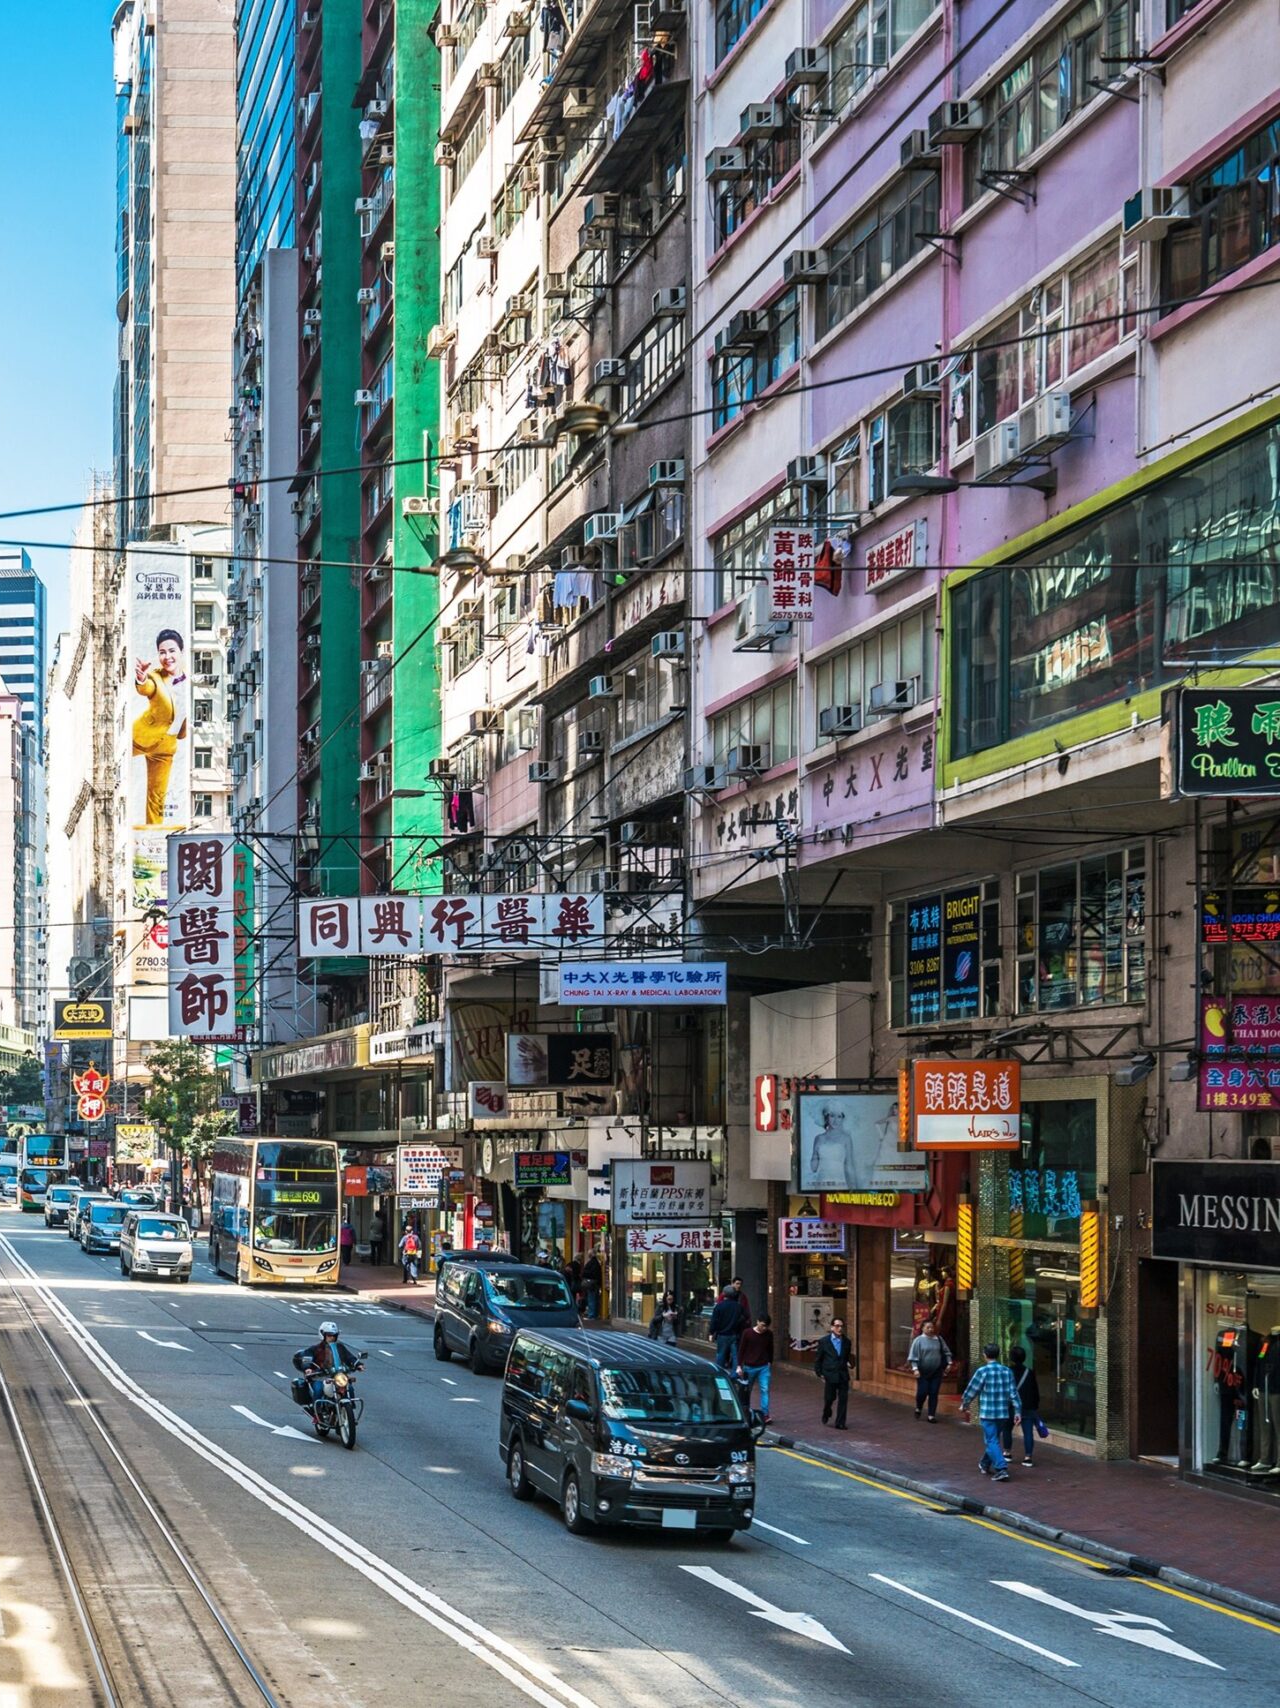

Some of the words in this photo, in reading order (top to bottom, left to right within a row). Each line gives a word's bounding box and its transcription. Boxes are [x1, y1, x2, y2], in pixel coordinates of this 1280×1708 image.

[773, 530, 796, 609] 黃錦華
[797, 533, 813, 607] 跌打骨科
[772, 611, 813, 619] 25757612
[946, 896, 980, 920] BRIGHT
[135, 957, 159, 967] 2780
[563, 970, 723, 984] 中大X光醫學化驗所
[563, 989, 590, 997] CHUNG
[593, 989, 604, 997] TAI
[674, 988, 723, 996] LABORATORY
[1232, 1029, 1259, 1039] THAI
[82, 1097, 101, 1116] 押
[302, 1191, 320, 1203] 690
[1205, 1302, 1246, 1319] SALE
[730, 1450, 748, 1463] 947
